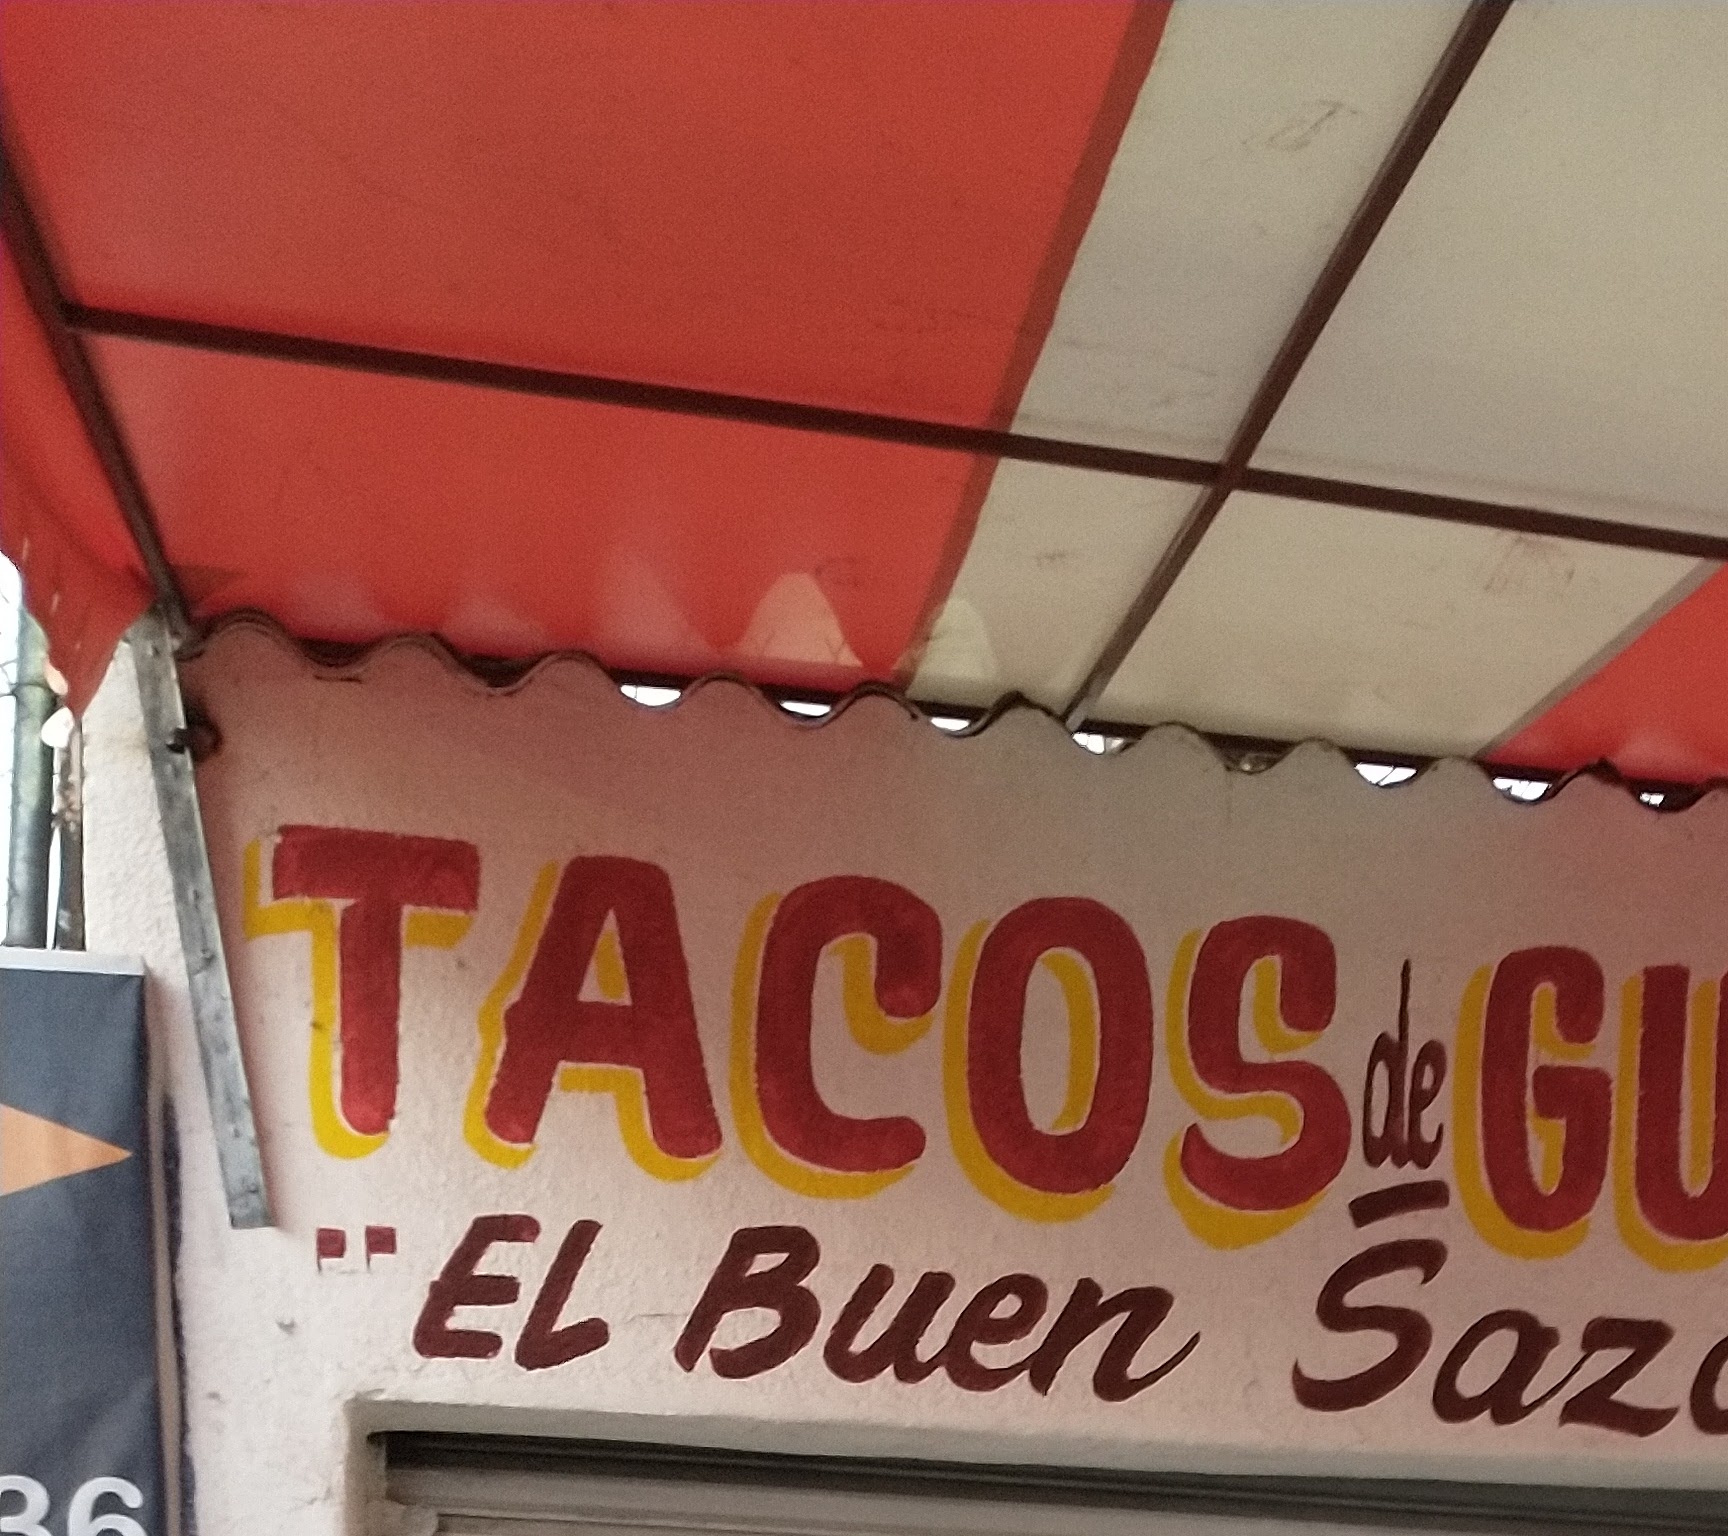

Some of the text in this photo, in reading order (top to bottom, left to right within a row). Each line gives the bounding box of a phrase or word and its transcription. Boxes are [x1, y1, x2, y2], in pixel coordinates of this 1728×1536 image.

[243, 824, 1353, 1250] TACOS
[1361, 959, 1446, 1172] de
[672, 1223, 1201, 1403] Buen
